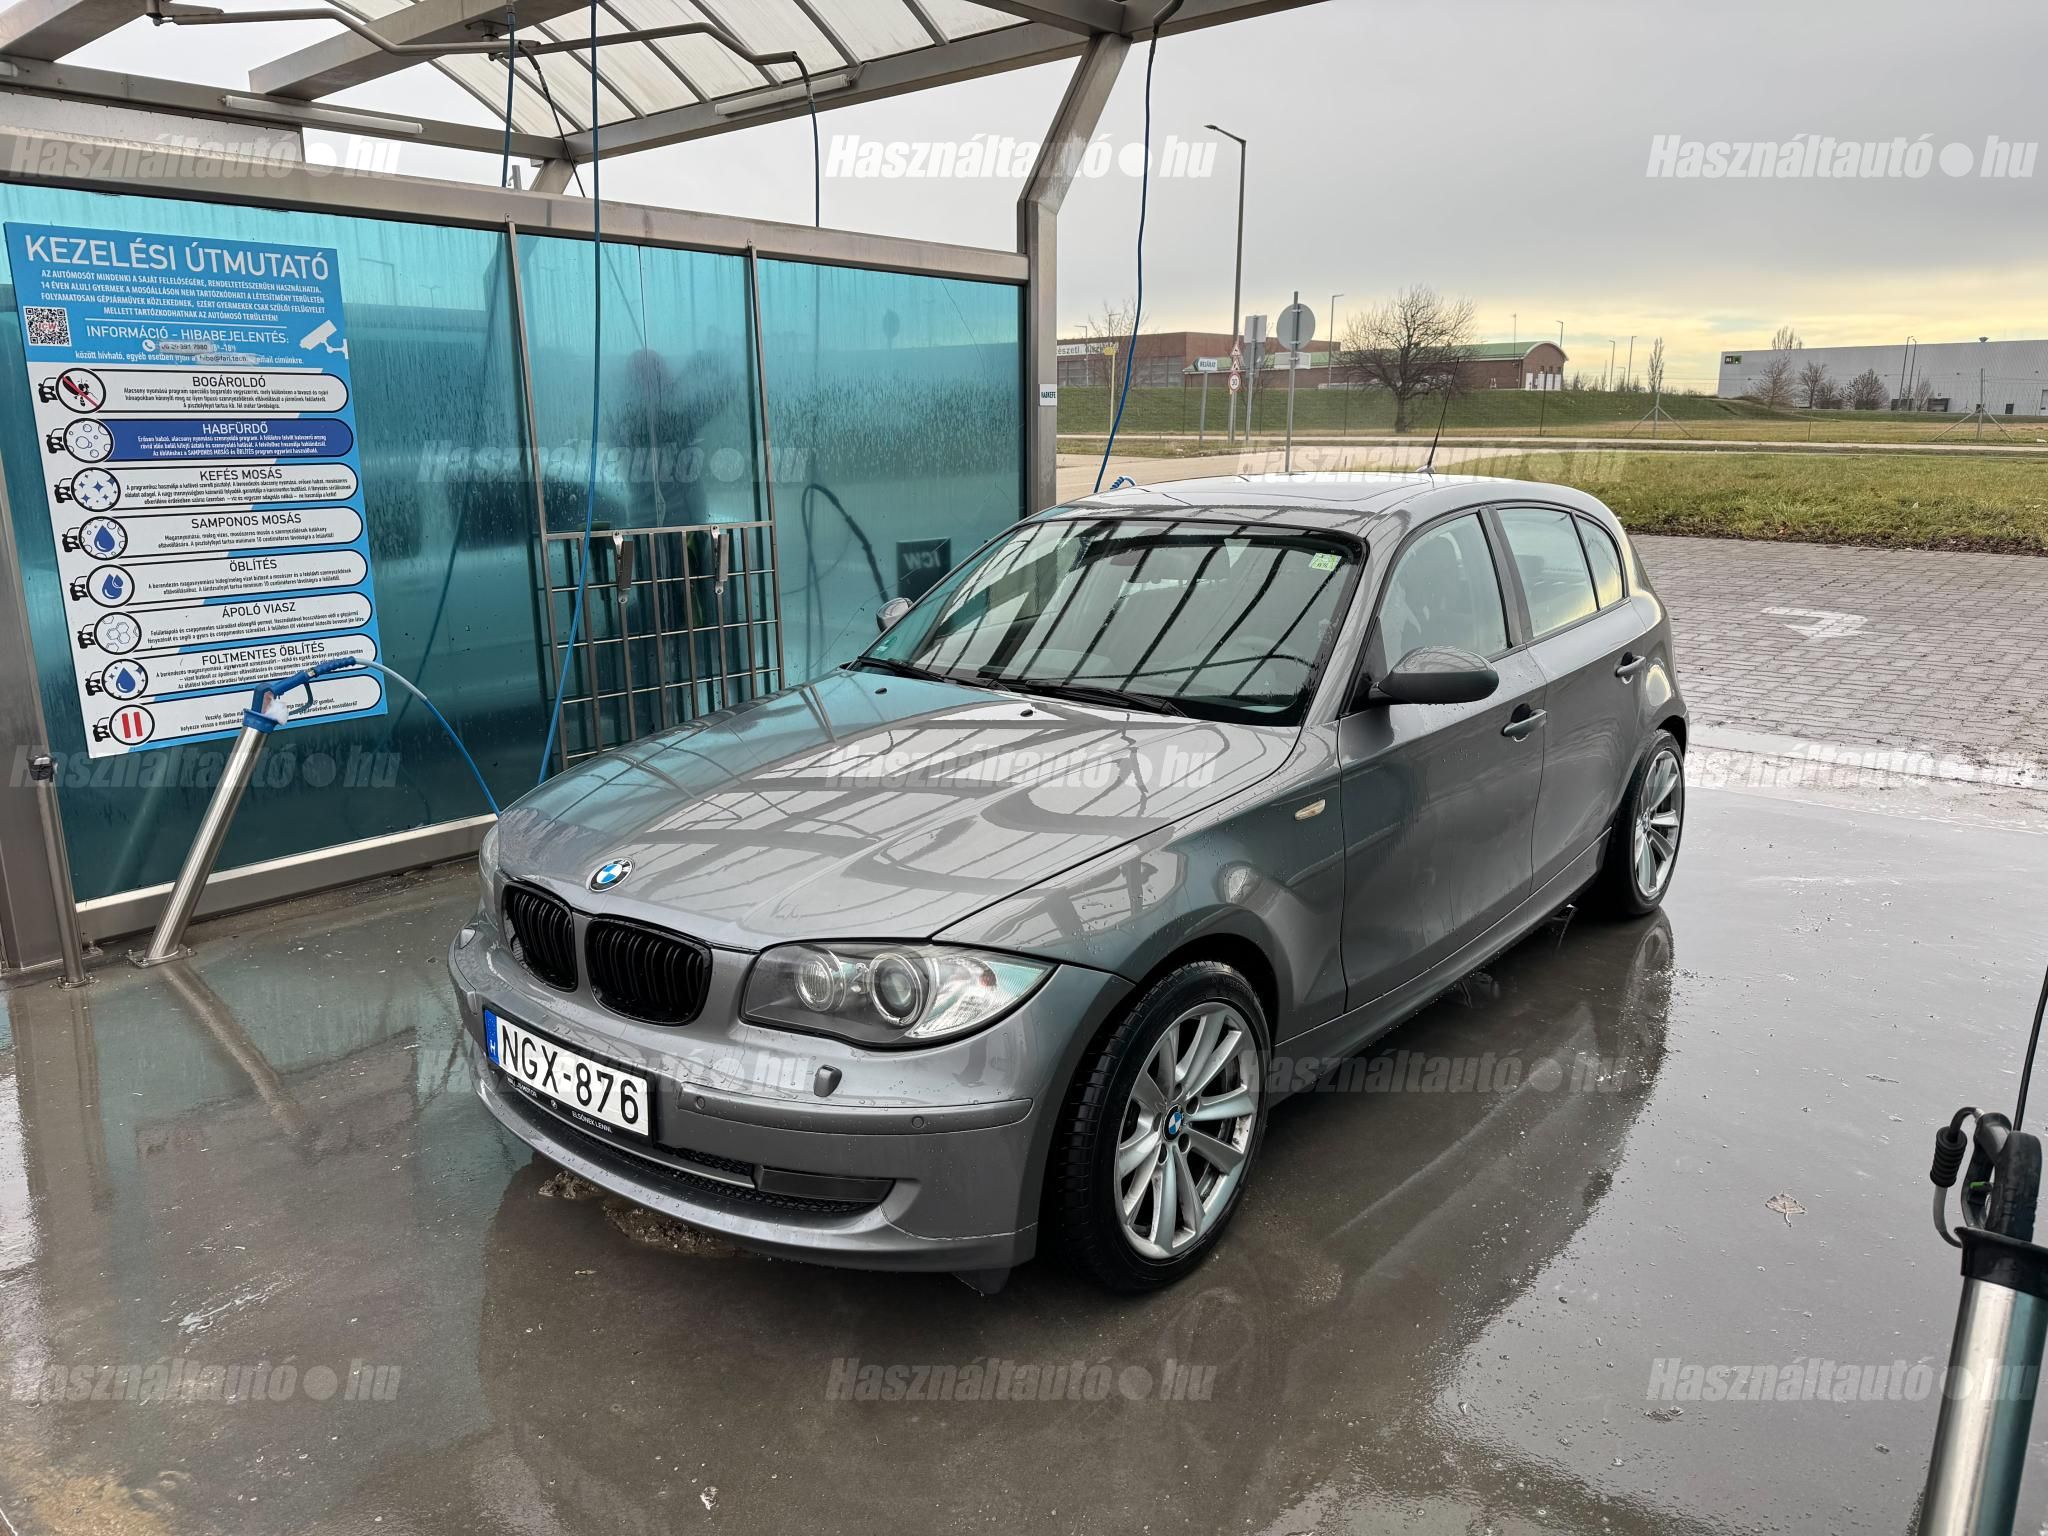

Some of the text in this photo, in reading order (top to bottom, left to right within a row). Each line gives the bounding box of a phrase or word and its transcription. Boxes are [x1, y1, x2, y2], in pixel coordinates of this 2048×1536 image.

[25, 235, 329, 281] KEZELÉSI ÚTMUTATÓ
[41, 269, 51, 277] AZ
[95, 272, 131, 282] MINDENKI
[131, 274, 138, 282] A
[138, 275, 158, 283] SAJÁT
[50, 281, 69, 290] ÉVEN
[70, 282, 91, 291] ALULI
[92, 283, 124, 292] GYERMEK
[124, 285, 130, 293] A
[180, 288, 195, 296] NEM
[40, 292, 95, 302] FOLYAMATOSAN
[196, 300, 215, 308] EZÉRT
[216, 301, 253, 310] GYERMEKEK
[103, 306, 133, 315] MELLETT
[85, 323, 168, 339] INFORMÁCIÓ
[180, 327, 288, 343] HIBABEJELENTÉS:
[191, 374, 266, 387] BOGÁROLDÓ
[201, 421, 268, 433] HABFÜRDŐ
[199, 466, 282, 481] KEFÉS MOSÁS
[190, 511, 301, 528] SAMPONOS MOSÁS
[228, 557, 277, 572] ÖBLÍTÉS
[221, 603, 260, 618] ÁPOLÓ
[263, 601, 296, 614] VIASZ
[201, 648, 276, 665] FOLTMENTES
[278, 640, 324, 656] ÖBLÍTÉS
[490, 1040, 496, 1055] H
[502, 1025, 639, 1125] NGX-876
